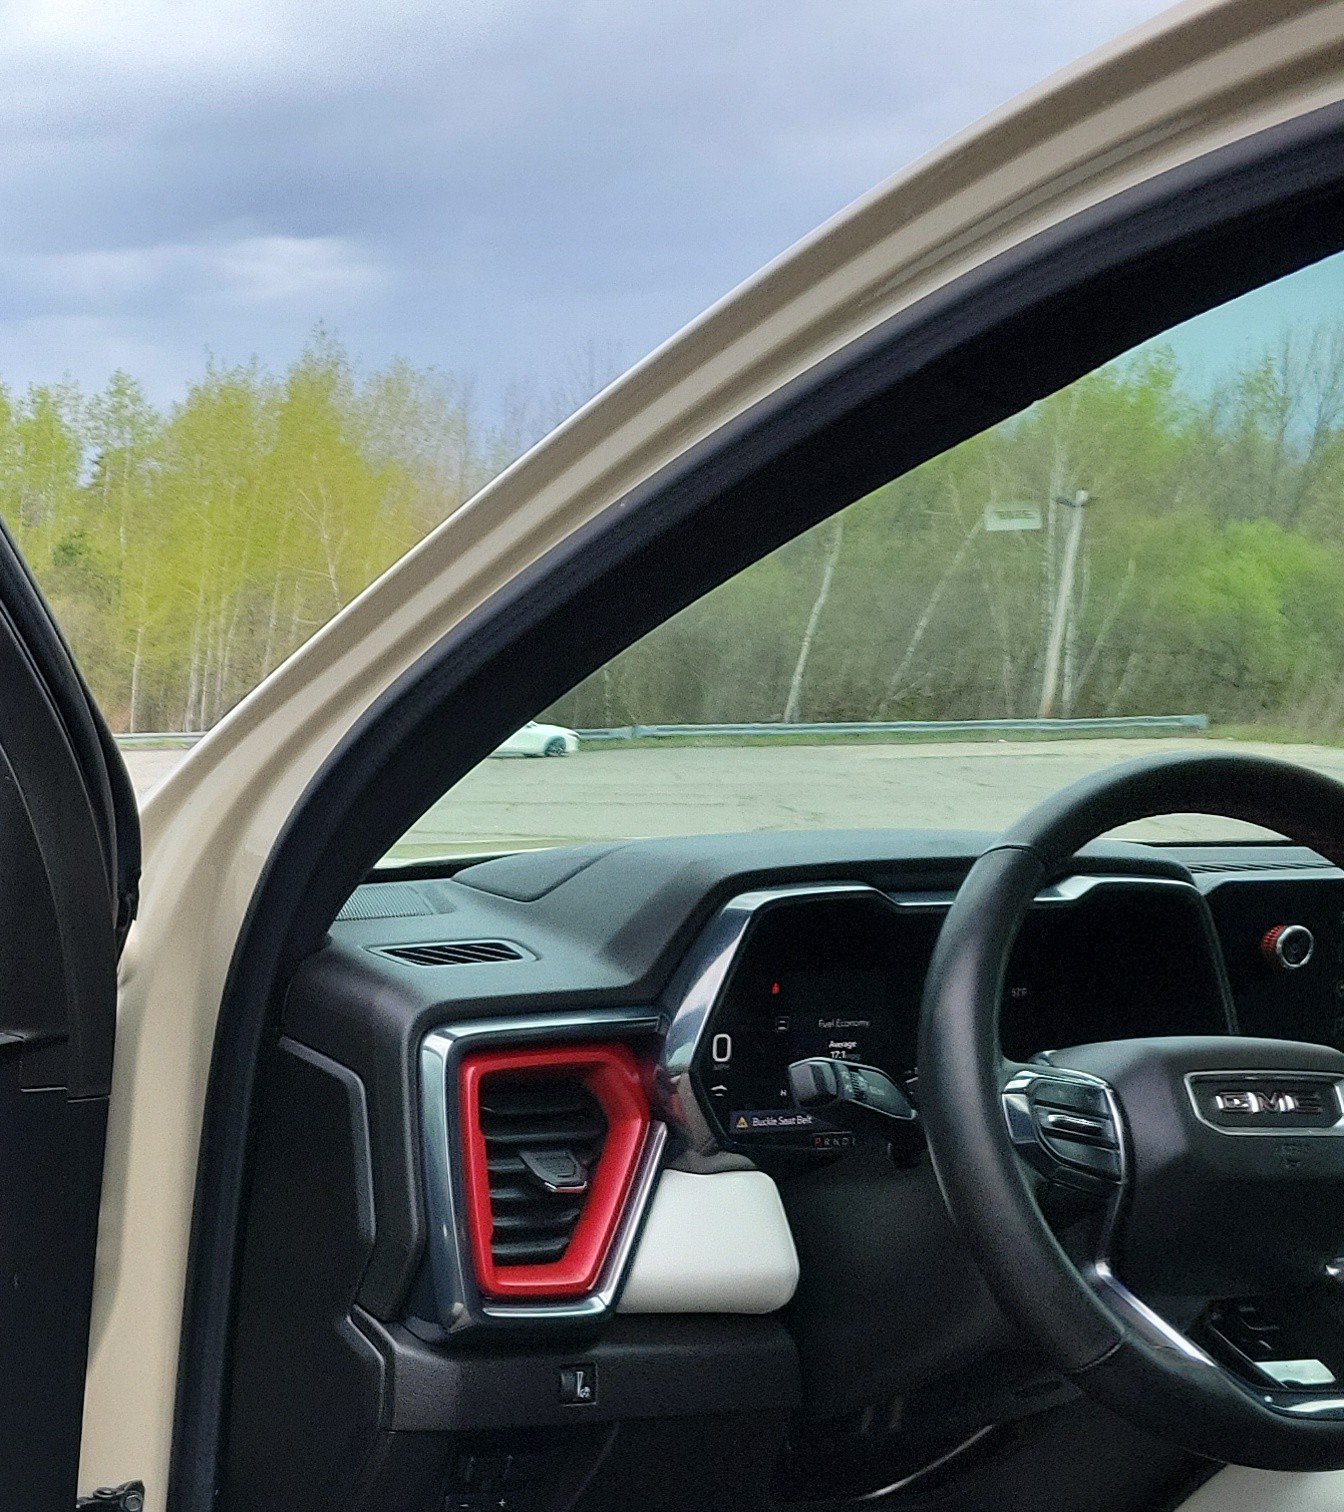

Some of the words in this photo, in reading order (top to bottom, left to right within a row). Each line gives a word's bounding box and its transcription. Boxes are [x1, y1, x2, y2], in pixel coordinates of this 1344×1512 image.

[818, 1018, 834, 1027] Fuel
[836, 1019, 870, 1027] Economy
[712, 1033, 732, 1062] 0
[828, 1040, 857, 1050] Average
[1214, 1090, 1323, 1115] GMC
[752, 1116, 778, 1127] Buckle
[779, 1116, 796, 1126] Seat
[796, 1114, 813, 1126] Belt
